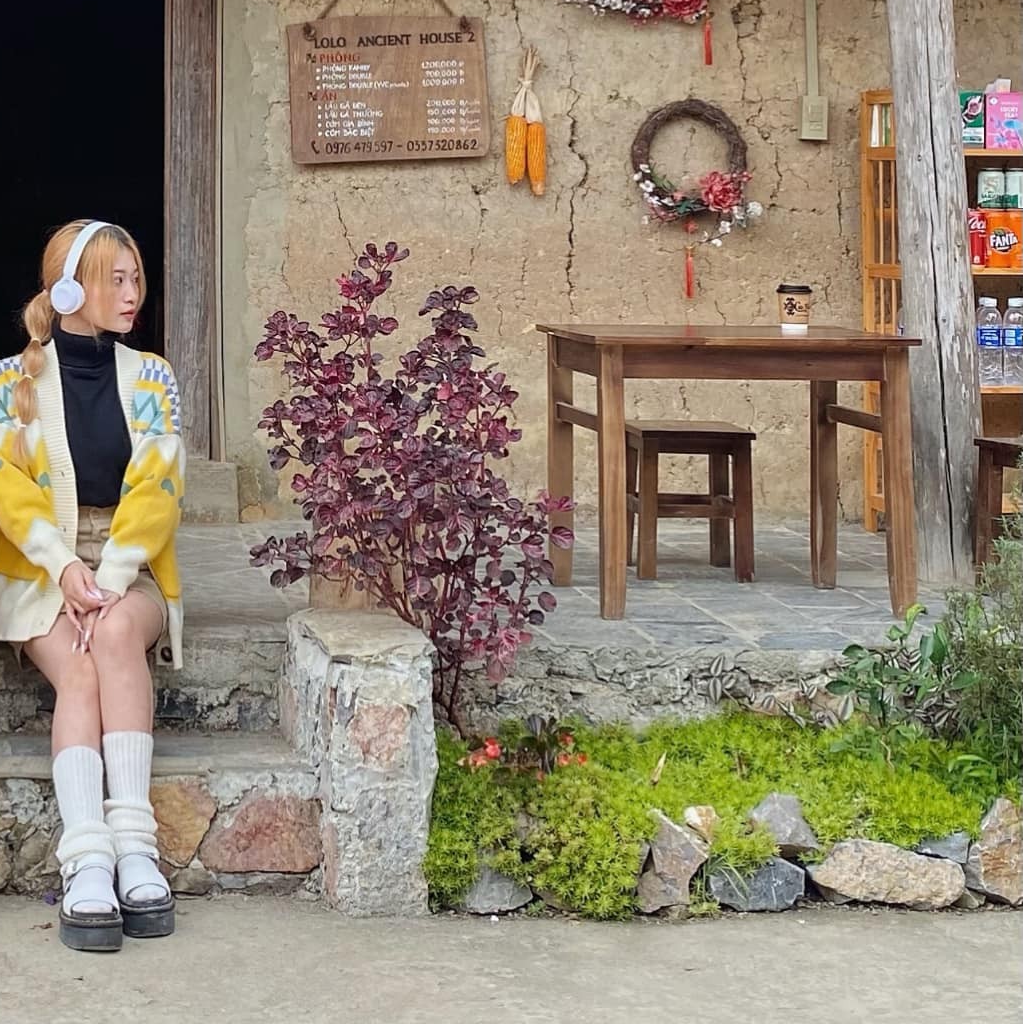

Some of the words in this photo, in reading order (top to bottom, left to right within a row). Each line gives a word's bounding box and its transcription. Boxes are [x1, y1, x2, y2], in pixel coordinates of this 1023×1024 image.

[314, 37, 347, 50] LOLO
[357, 34, 412, 48] ANCIENT
[419, 32, 463, 45] HOUSE
[467, 31, 476, 43] 2
